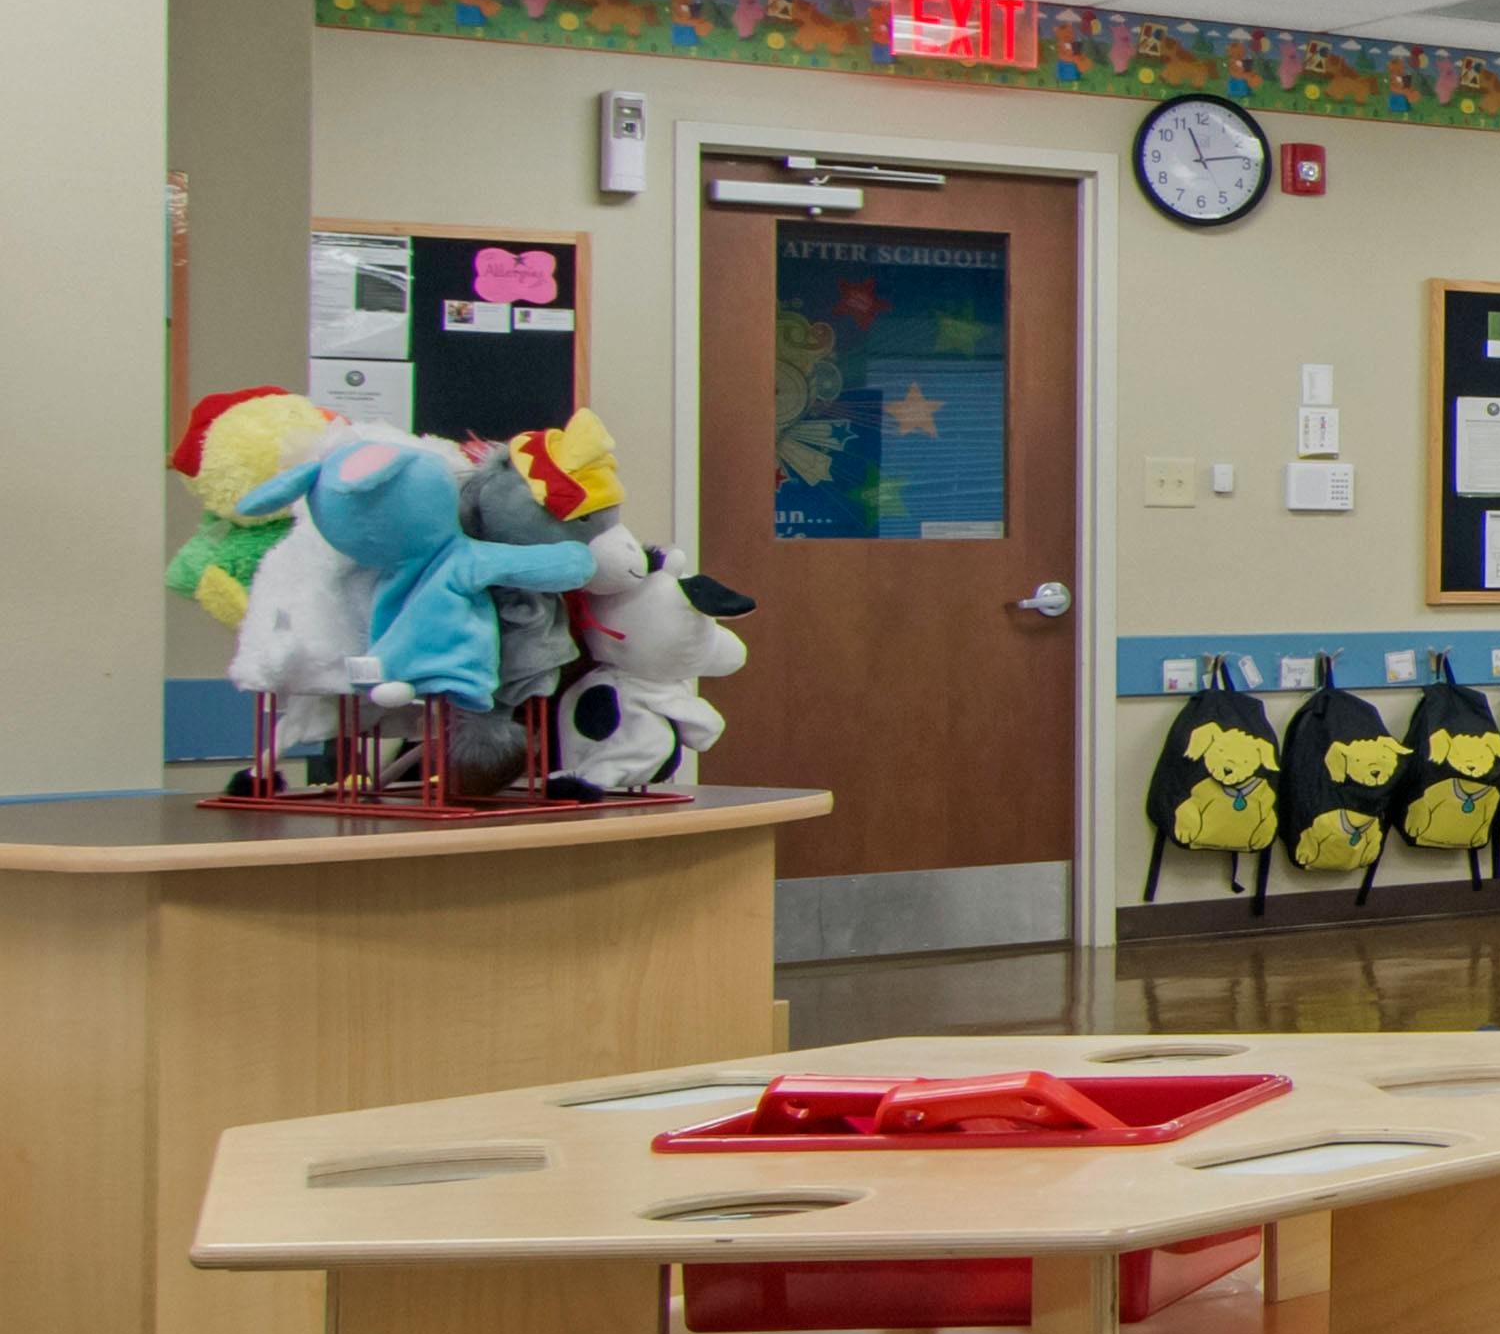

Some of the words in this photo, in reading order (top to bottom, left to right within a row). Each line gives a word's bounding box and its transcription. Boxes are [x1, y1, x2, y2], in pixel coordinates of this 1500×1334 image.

[1174, 117, 1187, 131] 11
[1195, 113, 1210, 126] 12
[1159, 129, 1174, 143] 10
[1151, 149, 1162, 164] 9
[1242, 155, 1252, 171] 3
[1158, 170, 1168, 185] 8
[1234, 178, 1244, 190] 4
[1175, 188, 1186, 202] 7
[1196, 195, 1207, 209] 6
[1218, 190, 1228, 205] 5
[783, 240, 868, 261] AFTER
[877, 245, 999, 269] SCHOOL!
